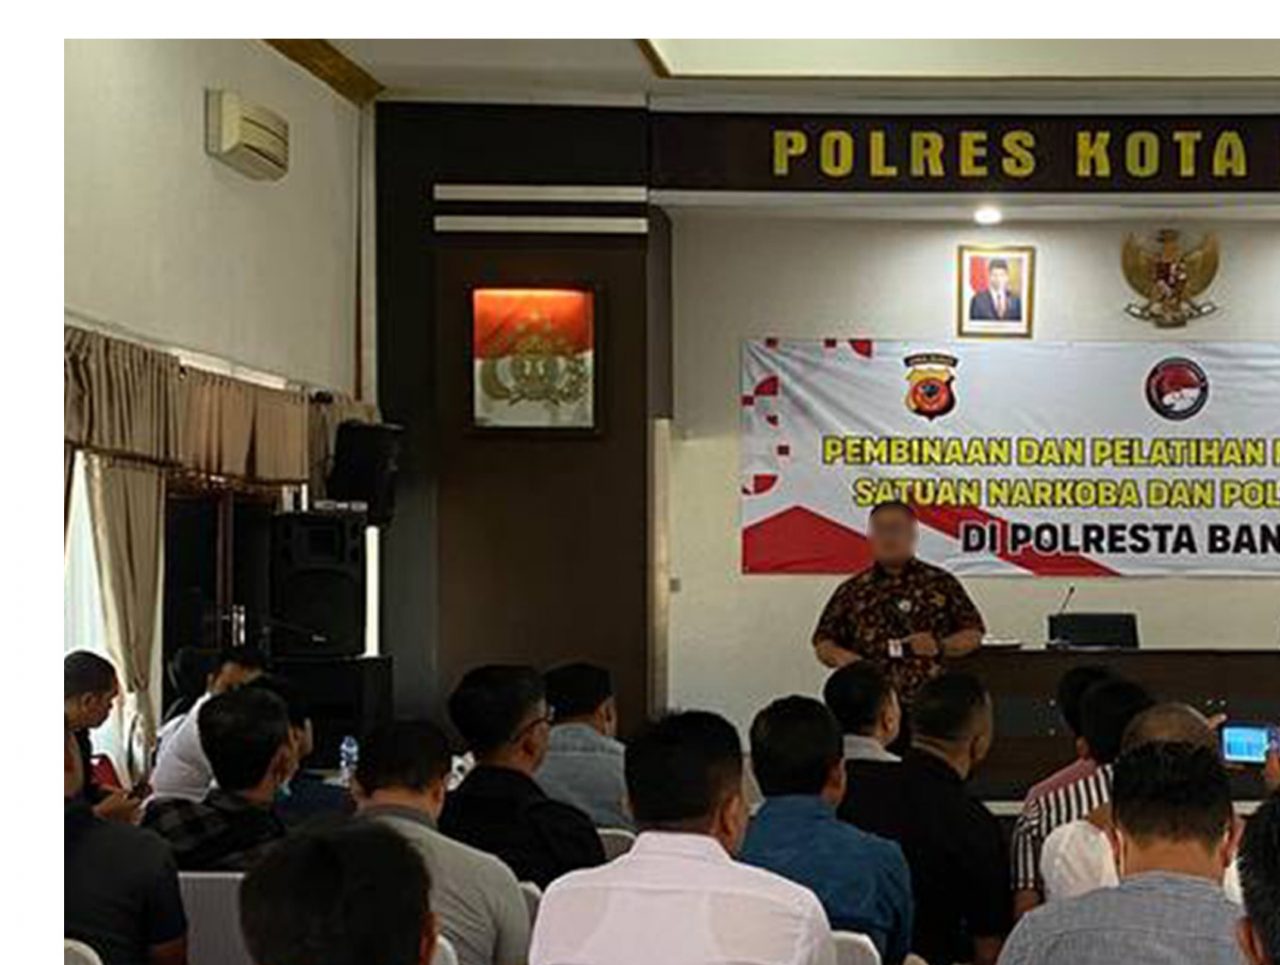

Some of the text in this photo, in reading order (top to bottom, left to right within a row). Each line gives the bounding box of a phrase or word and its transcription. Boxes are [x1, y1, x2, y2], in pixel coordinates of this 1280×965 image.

[773, 129, 1036, 178] POLRES
[1076, 130, 1248, 178] KOTA
[823, 436, 1010, 466] PEMBINAAN
[1016, 437, 1088, 466] DAN
[1091, 437, 1265, 467] PELATIHAN
[854, 478, 982, 507] SATUAN
[987, 478, 1141, 508] NARKOBA
[1146, 479, 1213, 508] DAN
[963, 523, 998, 552] DI
[1012, 523, 1198, 553] POLRESTA
